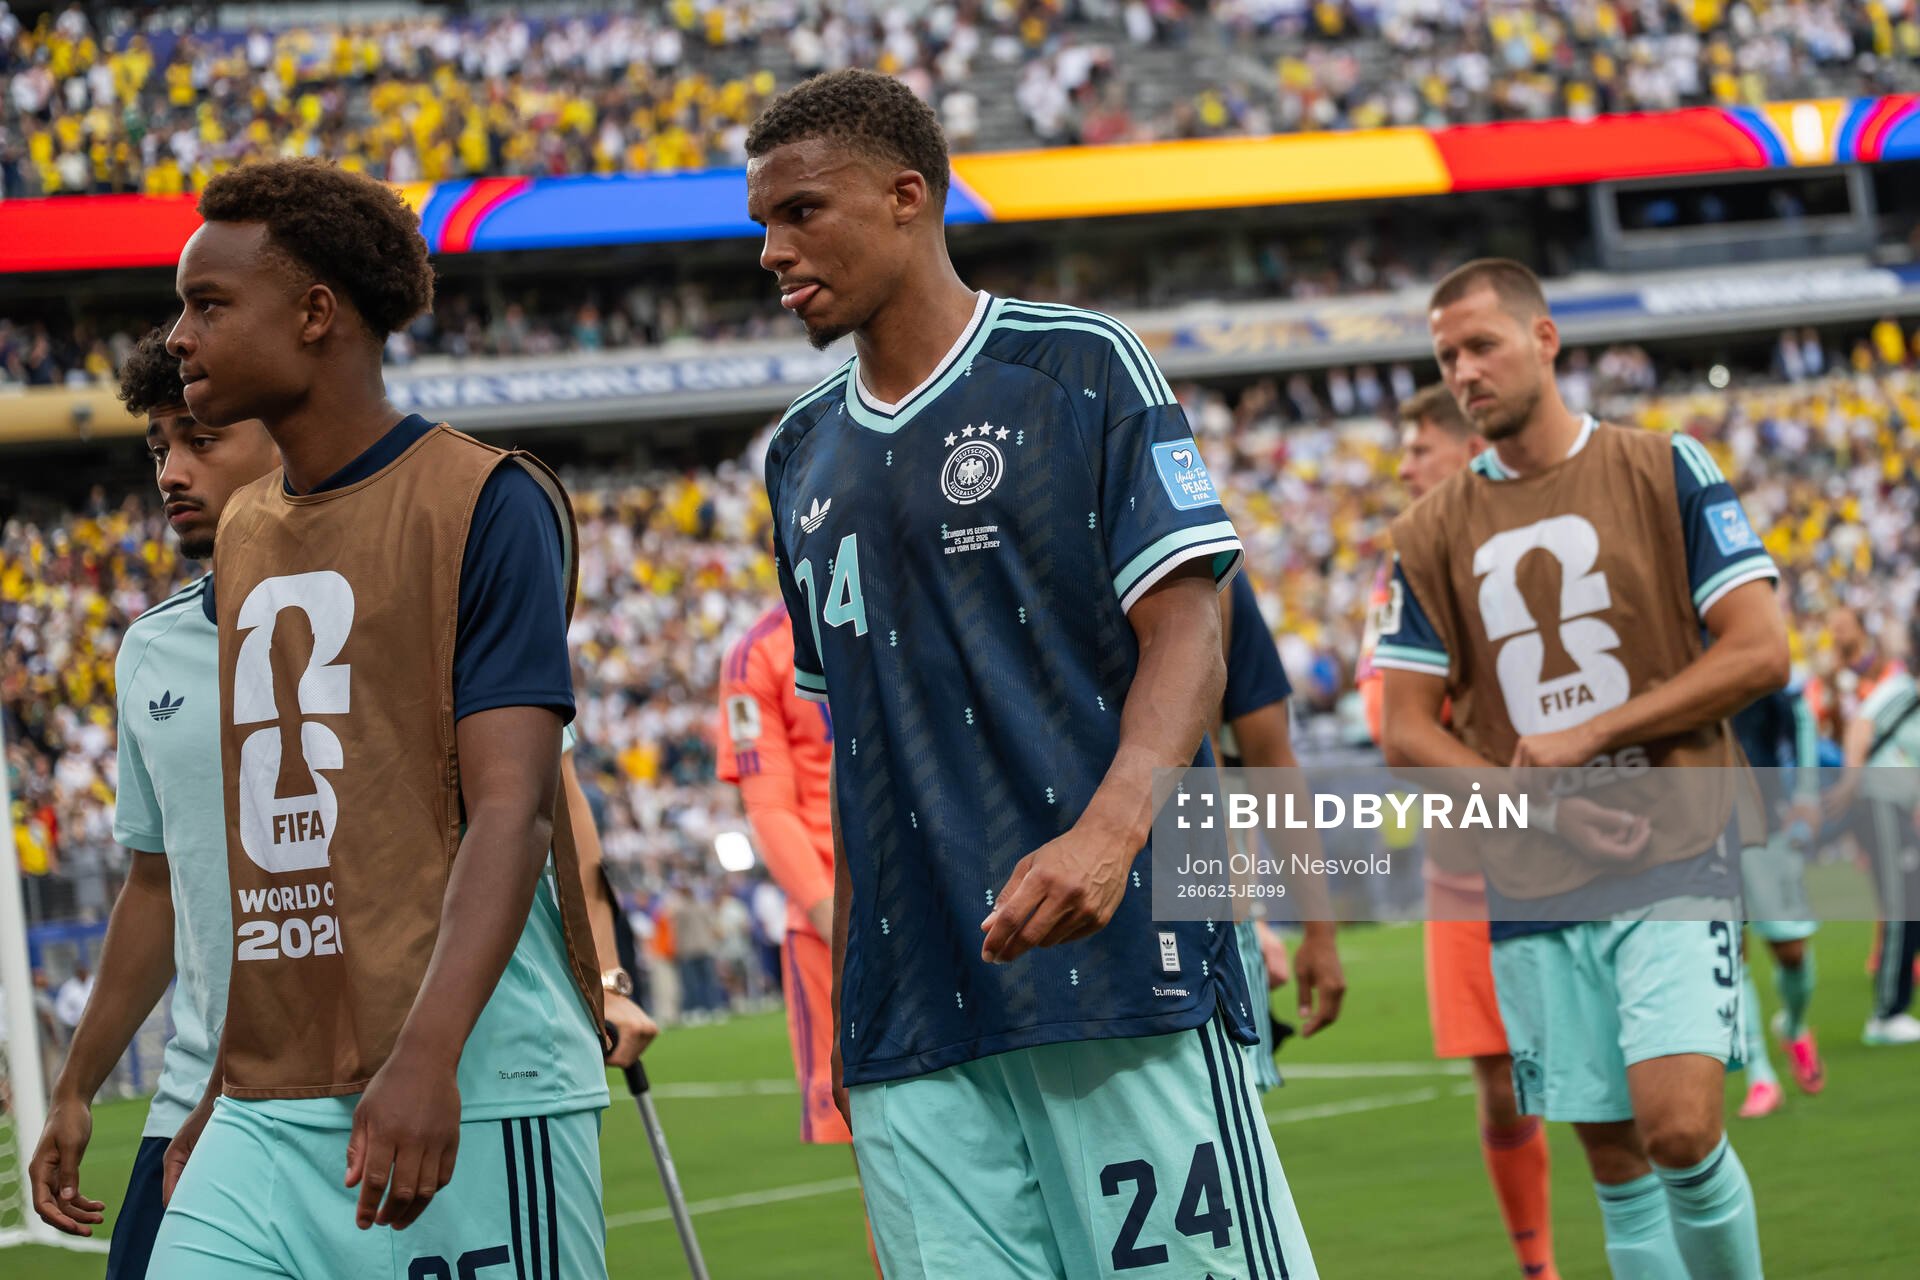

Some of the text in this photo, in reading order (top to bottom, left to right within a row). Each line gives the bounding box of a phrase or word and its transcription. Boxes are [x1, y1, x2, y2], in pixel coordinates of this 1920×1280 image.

[955, 447, 990, 463] DEUTSCHER
[1182, 480, 1211, 494] PEACE
[944, 540, 1000, 554] NEW YORK NEW JERSEY
[1539, 684, 1595, 716] FIFA
[272, 809, 326, 844] FIFA
[238, 883, 321, 913] WORLD
[237, 914, 344, 961] 202
[1100, 1141, 1233, 1271] 24
